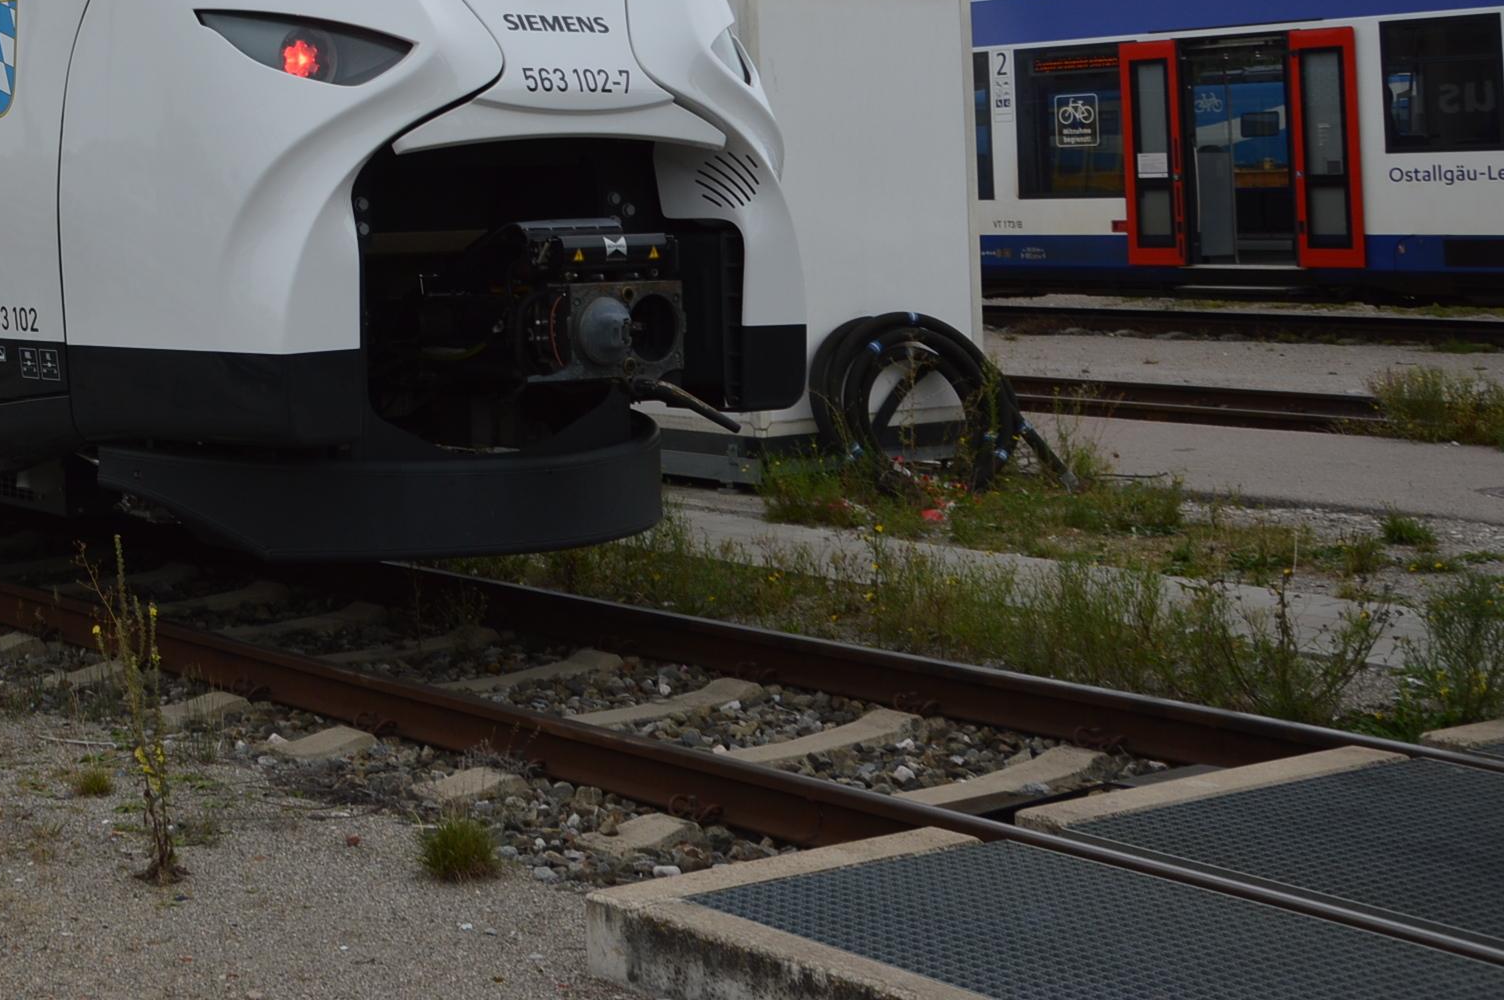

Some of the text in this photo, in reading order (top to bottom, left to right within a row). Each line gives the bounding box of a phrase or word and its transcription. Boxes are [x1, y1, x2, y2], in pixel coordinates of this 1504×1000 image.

[502, 13, 610, 34] SIEMENS
[996, 52, 1008, 76] 2
[522, 67, 631, 94] 563 102-7
[12, 306, 40, 333] 102
